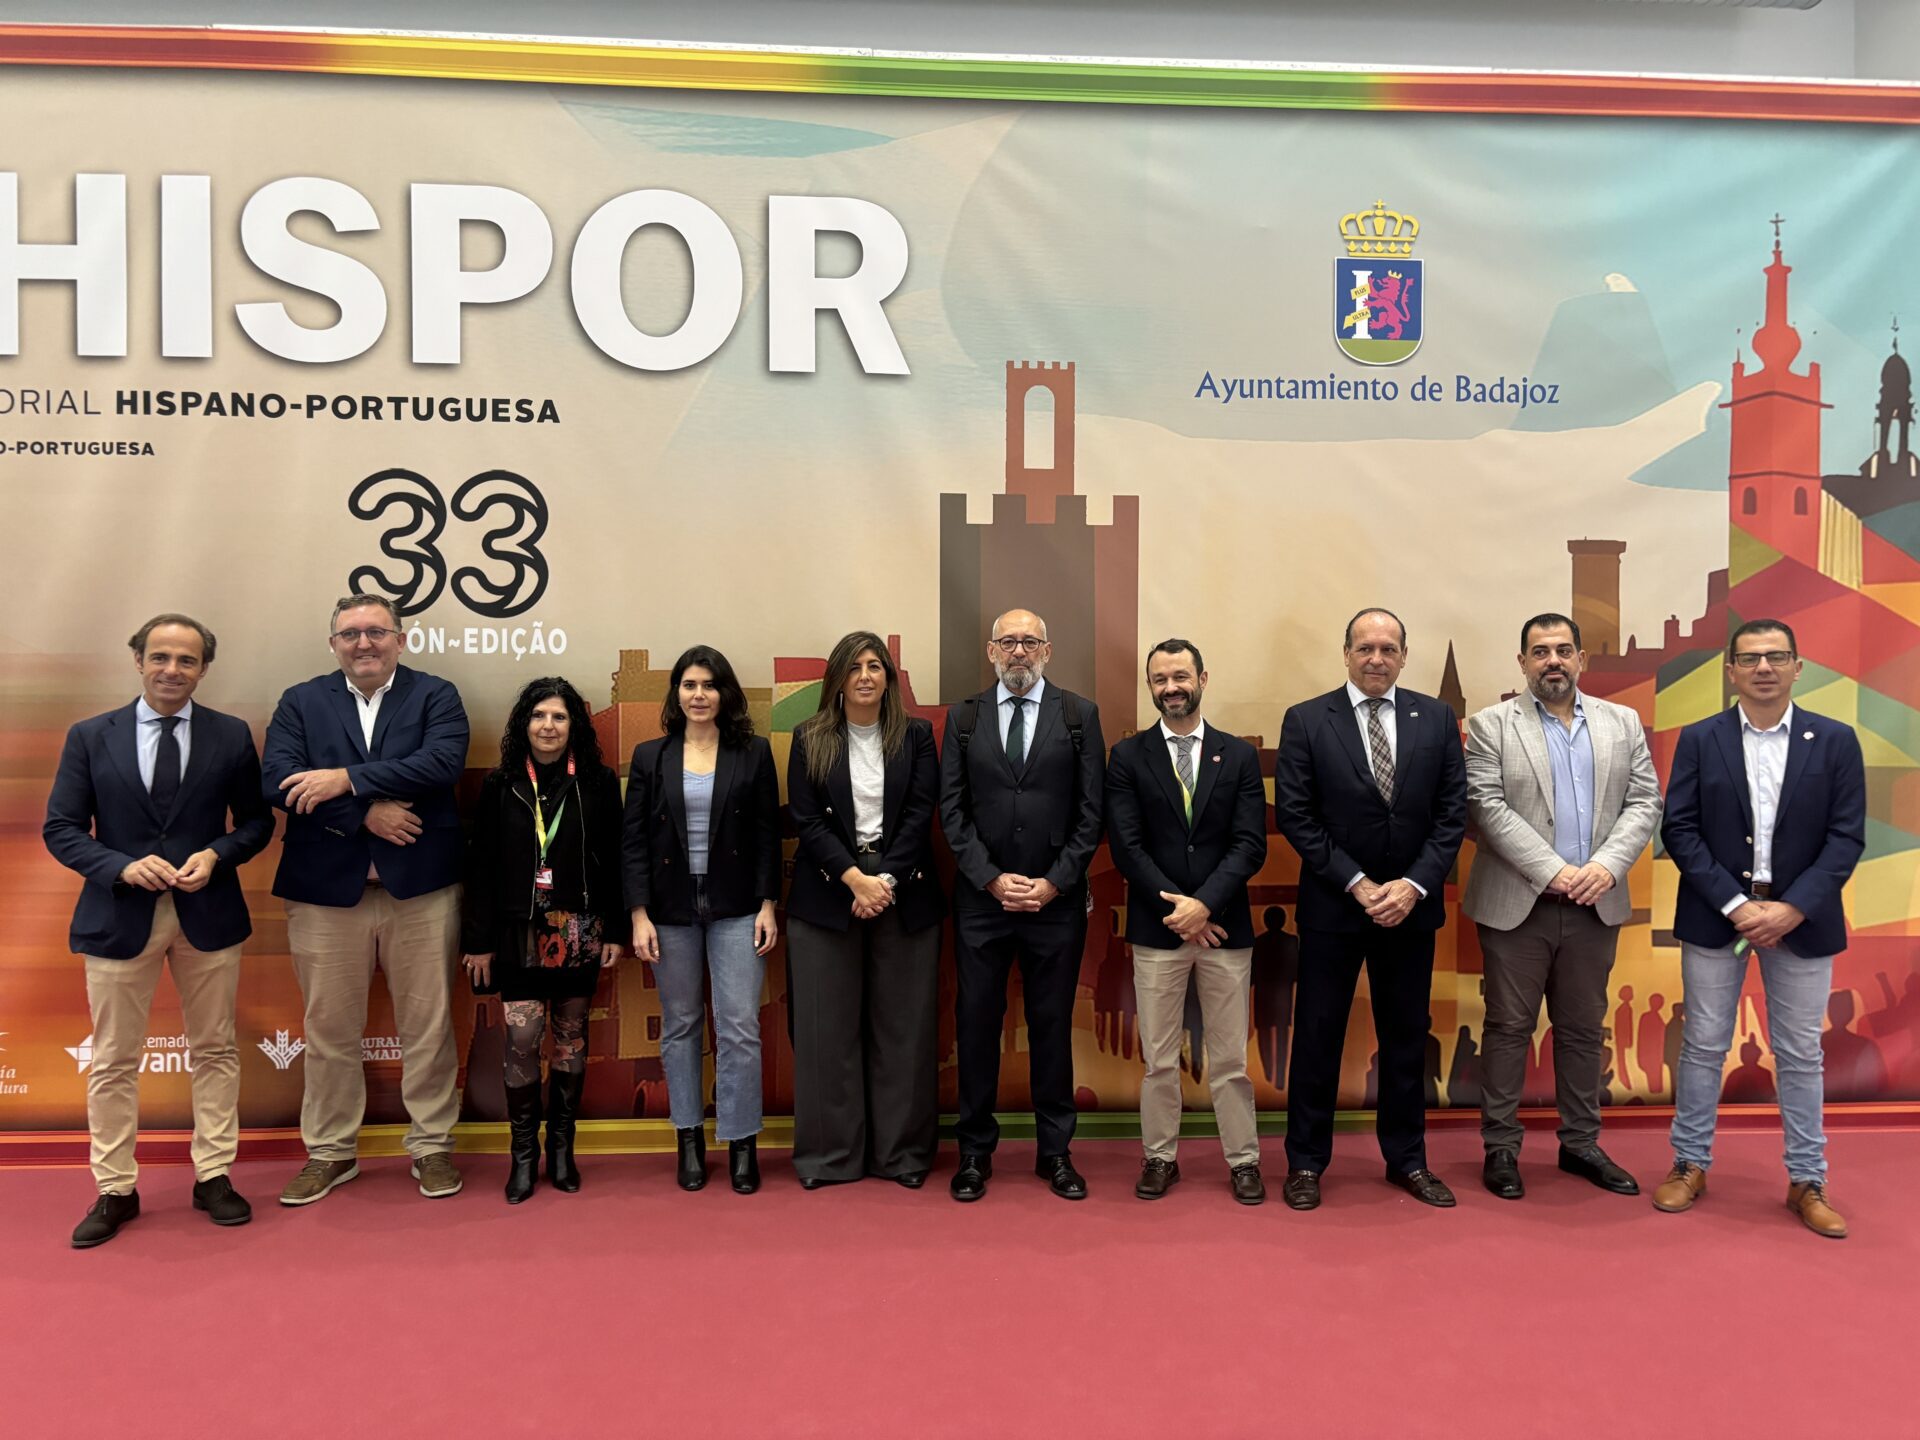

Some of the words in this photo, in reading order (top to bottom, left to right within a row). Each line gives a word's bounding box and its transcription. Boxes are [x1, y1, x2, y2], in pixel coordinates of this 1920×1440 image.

[1352, 311, 1370, 321] ULTRA
[116, 390, 561, 424] HISPANO-PORTUGUESA
[1194, 370, 1399, 404] Ayuntamiento
[1410, 375, 1443, 402] de
[1456, 375, 1560, 409] Badajoz
[348, 468, 549, 618] 33
[406, 620, 568, 661] ÓN~EDIÇÃO
